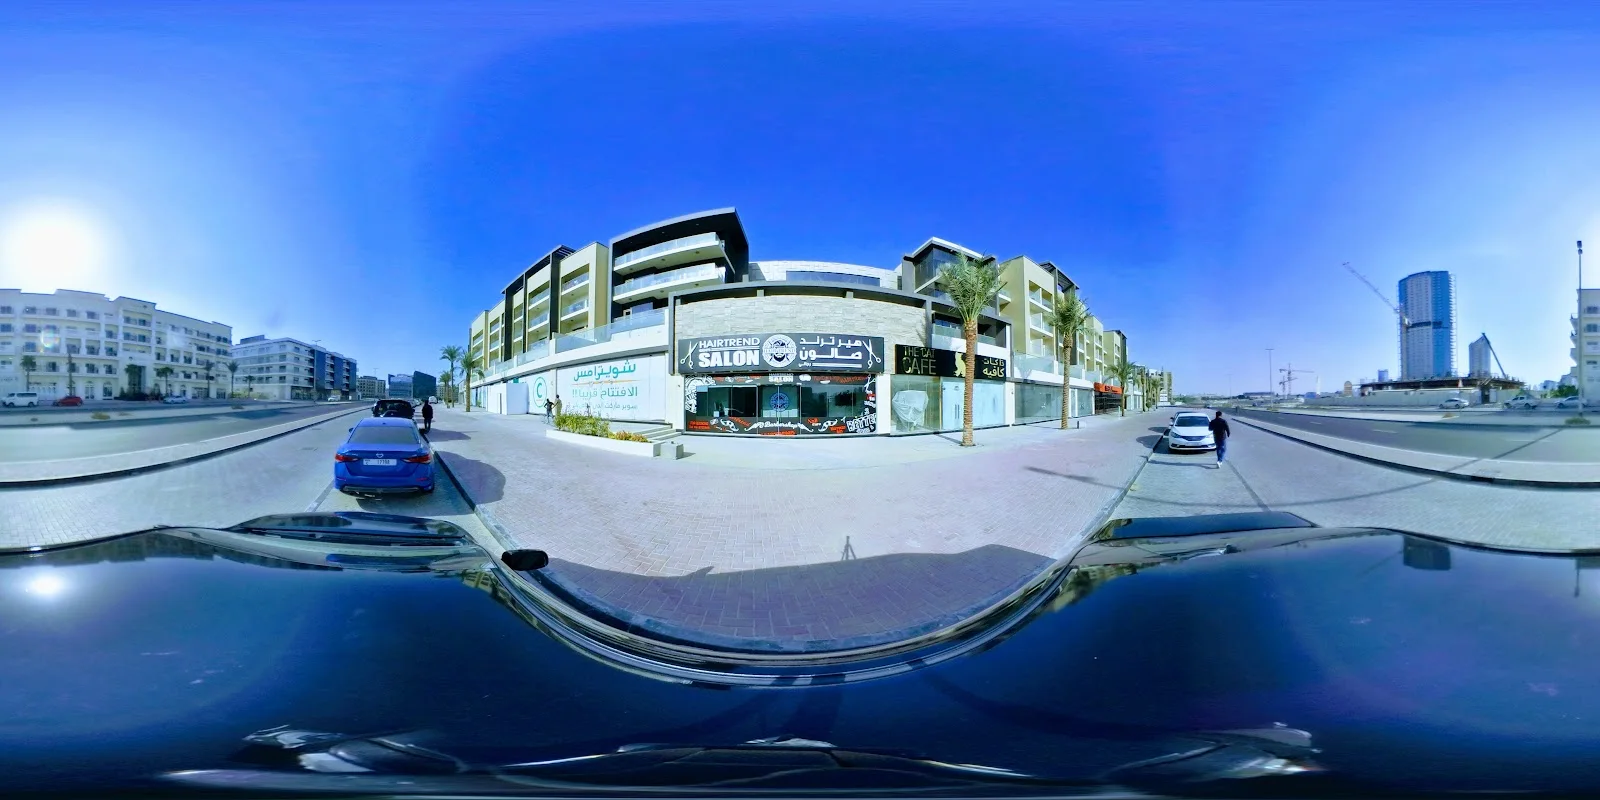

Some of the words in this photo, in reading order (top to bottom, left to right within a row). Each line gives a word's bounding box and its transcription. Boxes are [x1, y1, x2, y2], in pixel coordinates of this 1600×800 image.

[698, 337, 761, 349] HAIRTREND
[799, 336, 835, 347] ترند
[837, 339, 863, 349] هير
[698, 349, 760, 368] SALON
[799, 347, 863, 361] صالون
[903, 346, 920, 357] THE
[921, 347, 936, 359] CAT
[903, 357, 937, 374] CAFE
[983, 366, 1005, 378] كافيه
[600, 386, 638, 400] الافتتاح
